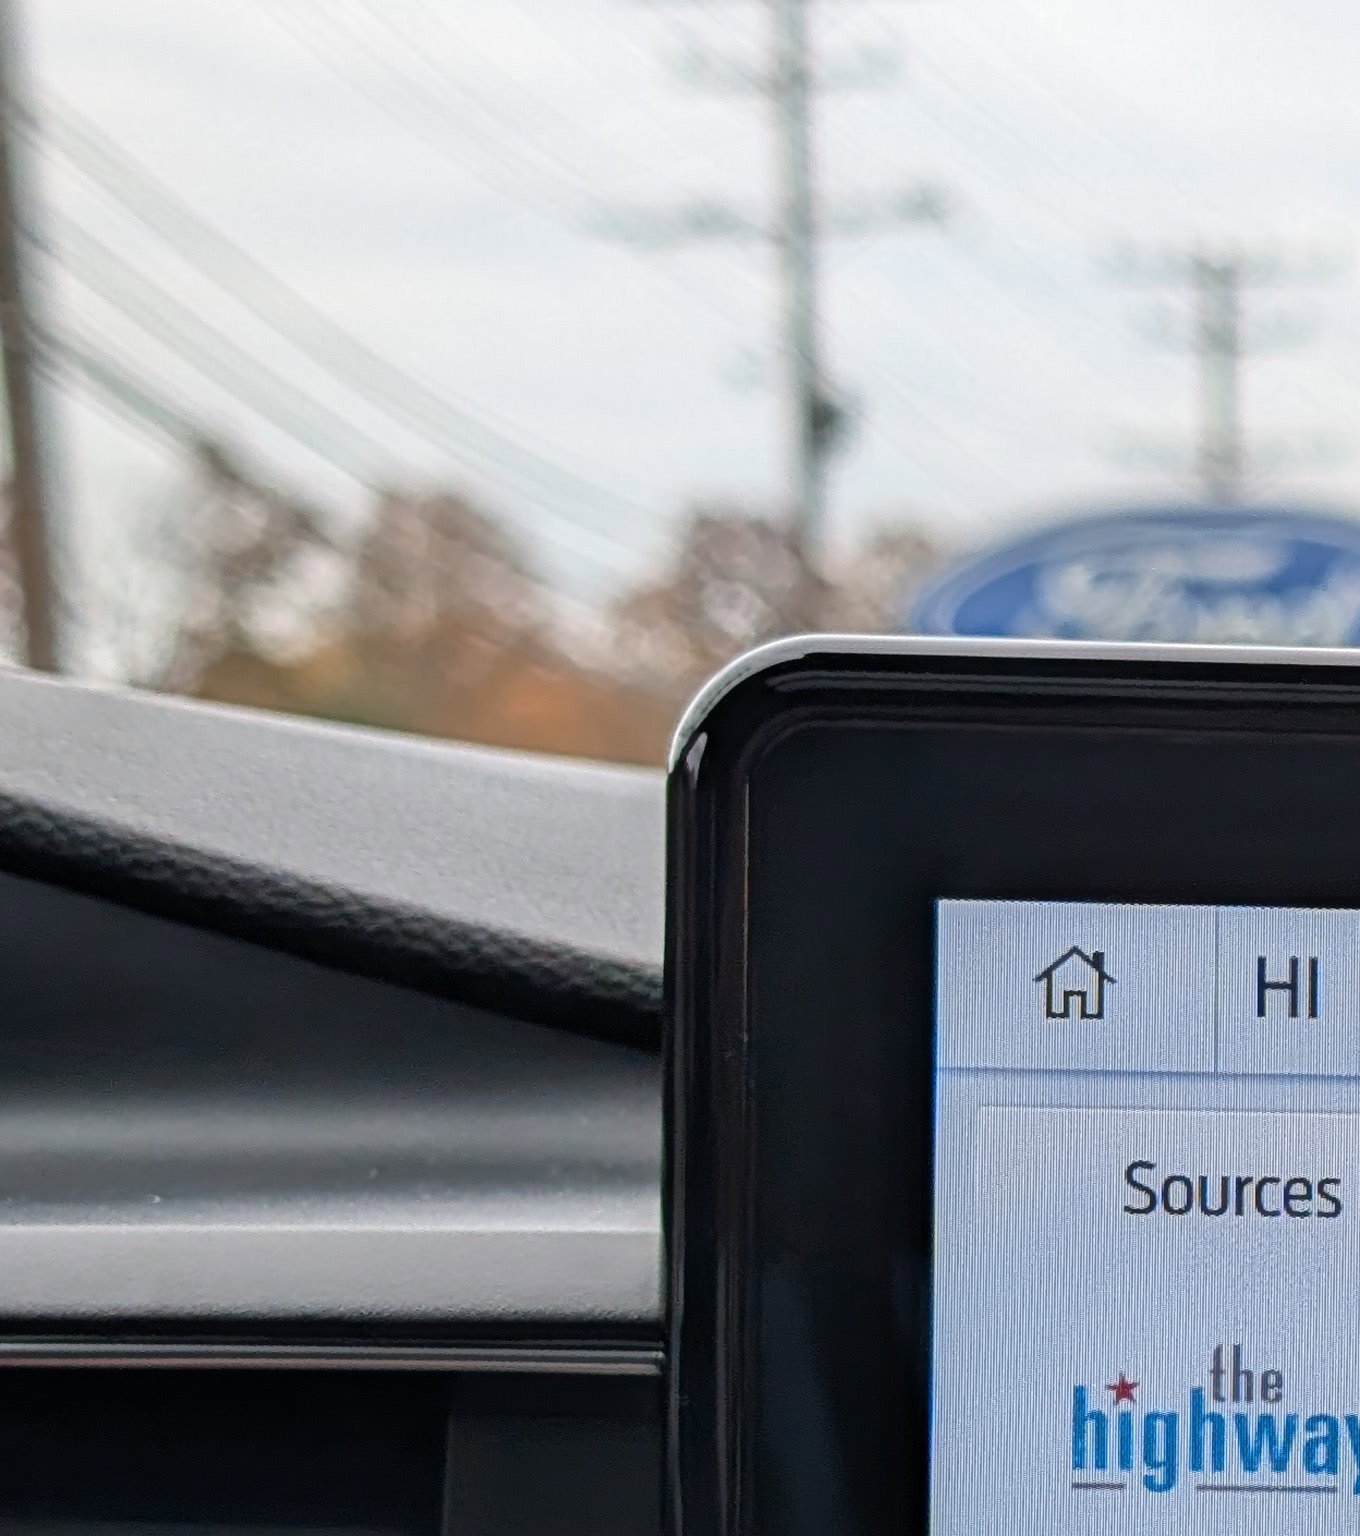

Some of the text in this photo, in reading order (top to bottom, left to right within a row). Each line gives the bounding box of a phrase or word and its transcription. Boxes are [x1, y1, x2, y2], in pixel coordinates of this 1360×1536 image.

[1256, 956, 1319, 1019] HI
[1123, 1160, 1343, 1219] Sources
[1211, 1344, 1283, 1403] the
